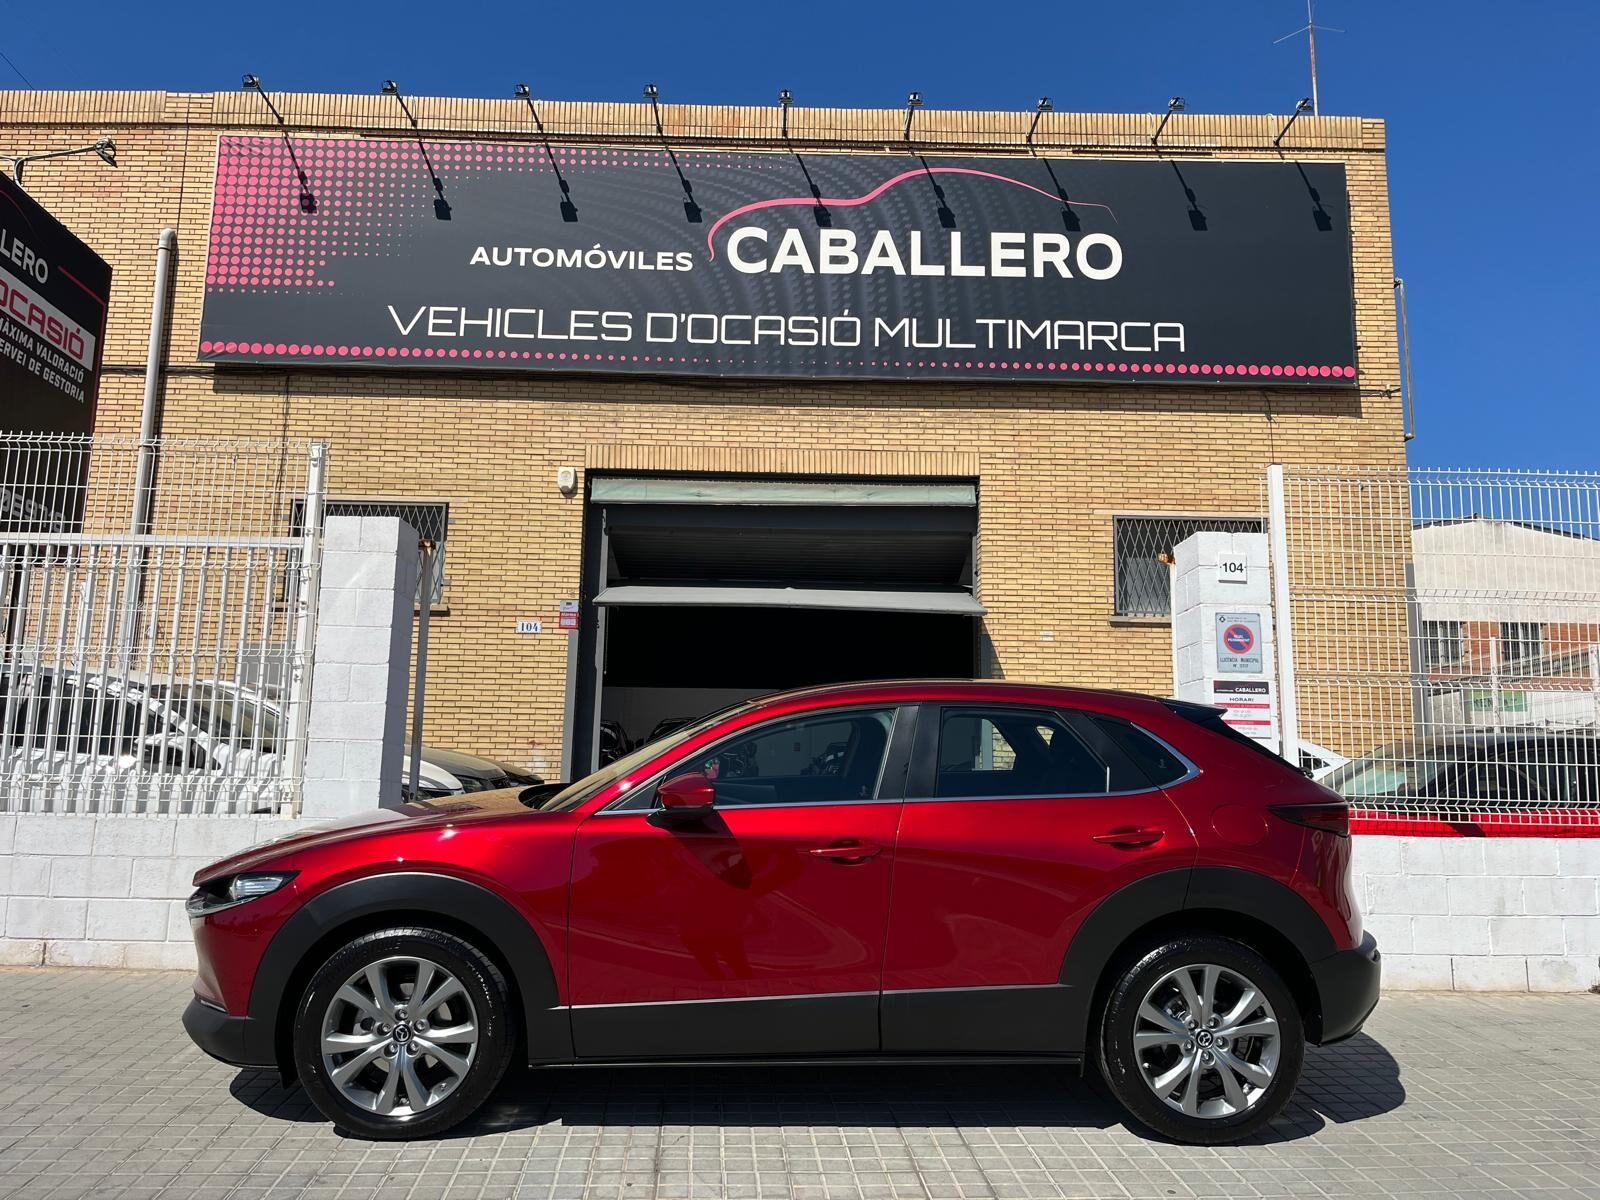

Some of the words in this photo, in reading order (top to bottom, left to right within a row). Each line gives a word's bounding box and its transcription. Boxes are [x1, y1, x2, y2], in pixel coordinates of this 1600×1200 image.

[470, 243, 693, 272] AUTOMÓVILES
[726, 226, 1123, 281] CABALLERO
[387, 305, 633, 342] VEHICLES
[645, 309, 862, 347] D'OCASIÓ
[874, 317, 1185, 352] MULTIMARCA
[28, 358, 41, 375] DE
[42, 367, 84, 403] GESTORIA
[36, 342, 84, 383] VALORACIÓ
[1222, 562, 1244, 573] 104
[521, 622, 538, 632] 104
